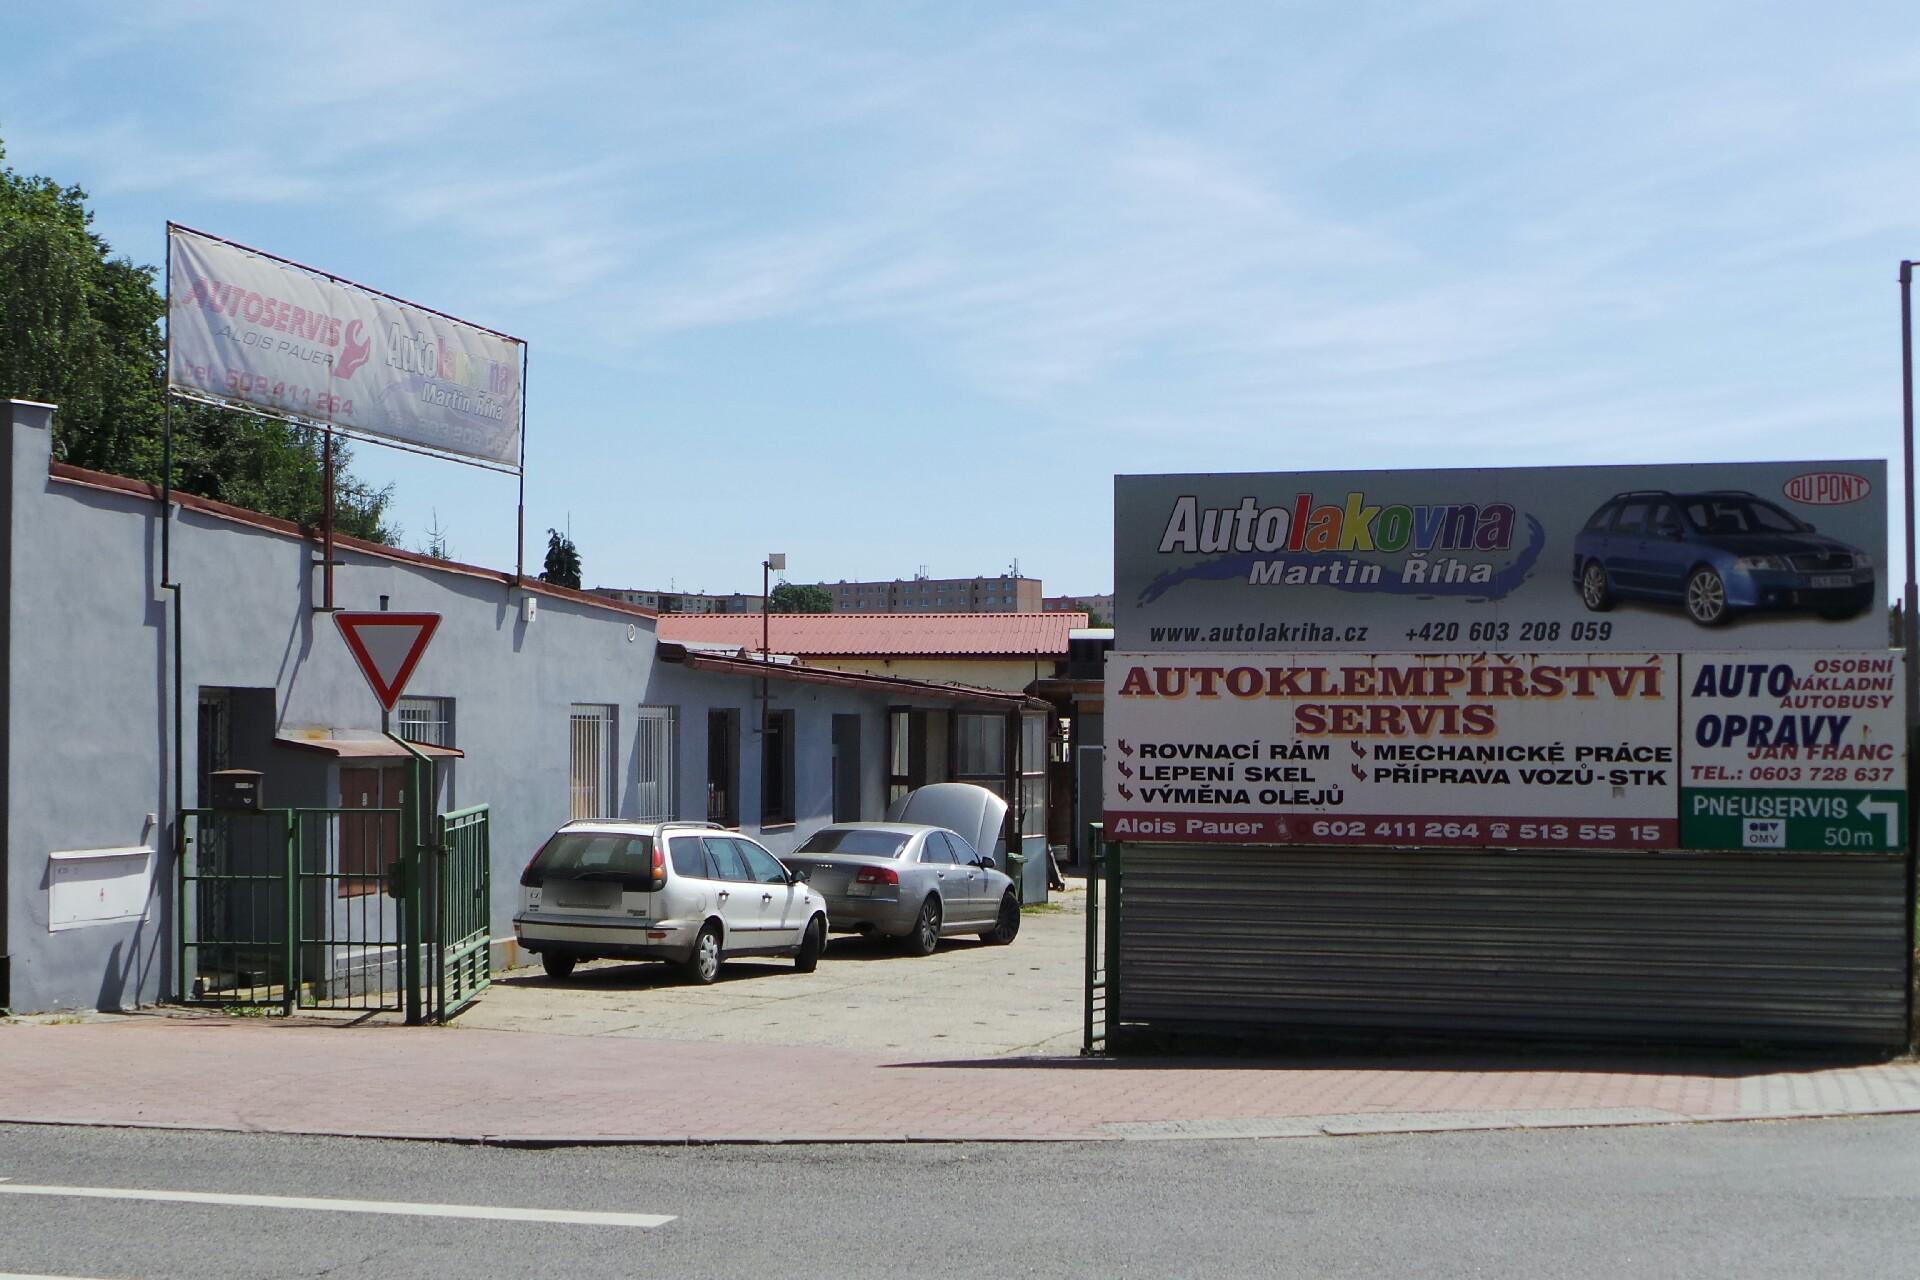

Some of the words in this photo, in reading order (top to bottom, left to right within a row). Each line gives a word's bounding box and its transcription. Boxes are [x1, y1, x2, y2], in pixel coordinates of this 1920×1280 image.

[181, 276, 343, 347] AUTOSERVIS
[216, 325, 274, 350] ALOIS
[277, 341, 334, 367] PAUER
[422, 381, 470, 412] Martin
[1158, 491, 1516, 552] Autolakovna
[1248, 558, 1383, 586] Martin
[1401, 552, 1493, 585] Říha
[1150, 622, 1369, 643] www.autolakriha.cz
[1405, 621, 1460, 642] +420
[1469, 621, 1510, 642] 603
[1519, 621, 1561, 642] 208
[1570, 621, 1613, 642] 059
[1814, 656, 1896, 673] OSOBNÍ
[1118, 654, 1665, 700] AUTOKLEMPÍŘSTVÍ
[1691, 664, 1794, 698] AUTO
[1790, 674, 1896, 691] NÁKLADNÍ
[1780, 695, 1894, 709] AUTOBUSY
[1295, 703, 1498, 739] SERVIS
[1695, 714, 1852, 748] OPRAVY
[1139, 740, 1261, 760] ROVNACÍ
[1269, 740, 1330, 761] RÁM
[1374, 742, 1565, 763] MECHANICKÉ
[1575, 742, 1673, 763] PRÁCE
[1747, 744, 1799, 761] JAN
[1806, 744, 1894, 761] FRANC
[1139, 762, 1235, 782] LEPENÍ
[1244, 766, 1316, 783] SKEL
[1374, 763, 1511, 785] PŘÍPRAVA
[1690, 765, 1743, 781] TEL.:
[1750, 766, 1801, 781] 0603
[1809, 767, 1848, 781] 728
[1854, 767, 1895, 782] 637
[1140, 783, 1251, 805] VÝMĚNA
[1258, 783, 1345, 806] OLEJŮ
[1693, 795, 1848, 818] PNEUSERVIS
[1114, 818, 1177, 835] Alois
[1186, 819, 1264, 836] Pauer
[1312, 820, 1366, 837] 602
[1374, 821, 1417, 838] 411
[1424, 822, 1480, 839] 264
[1519, 823, 1569, 840] 513
[1578, 824, 1617, 841] 55
[1630, 825, 1661, 842] 15
[1749, 833, 1779, 844] OMV
